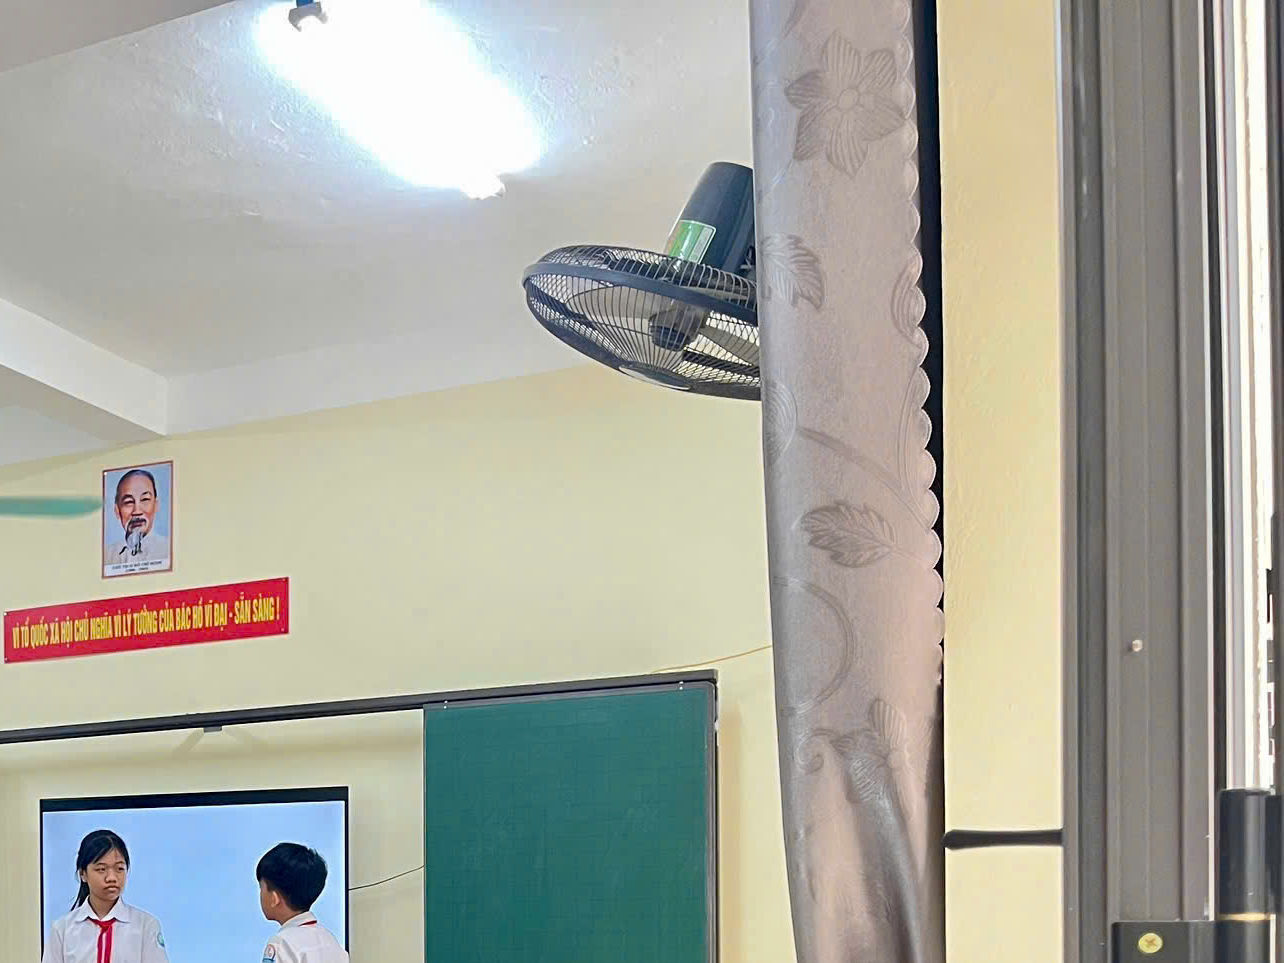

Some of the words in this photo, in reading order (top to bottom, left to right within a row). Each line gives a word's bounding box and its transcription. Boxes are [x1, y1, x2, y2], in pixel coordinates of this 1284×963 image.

[12, 622, 20, 649] VÌ
[30, 616, 49, 649] QUỐC
[49, 617, 60, 645] XÃ
[60, 616, 73, 648] HỘI
[74, 610, 89, 642] CHỦ
[90, 611, 113, 640] NGHĨA
[113, 609, 122, 638] VÌ
[122, 608, 132, 637] LÝ
[133, 603, 158, 636] TƯỞNG
[158, 601, 175, 632] CỦA
[175, 602, 192, 630] BÁC
[204, 599, 213, 628] VĨ
[213, 602, 228, 631] ĐẠI
[234, 591, 251, 624] SẴN
[252, 592, 275, 622] SÀNG
